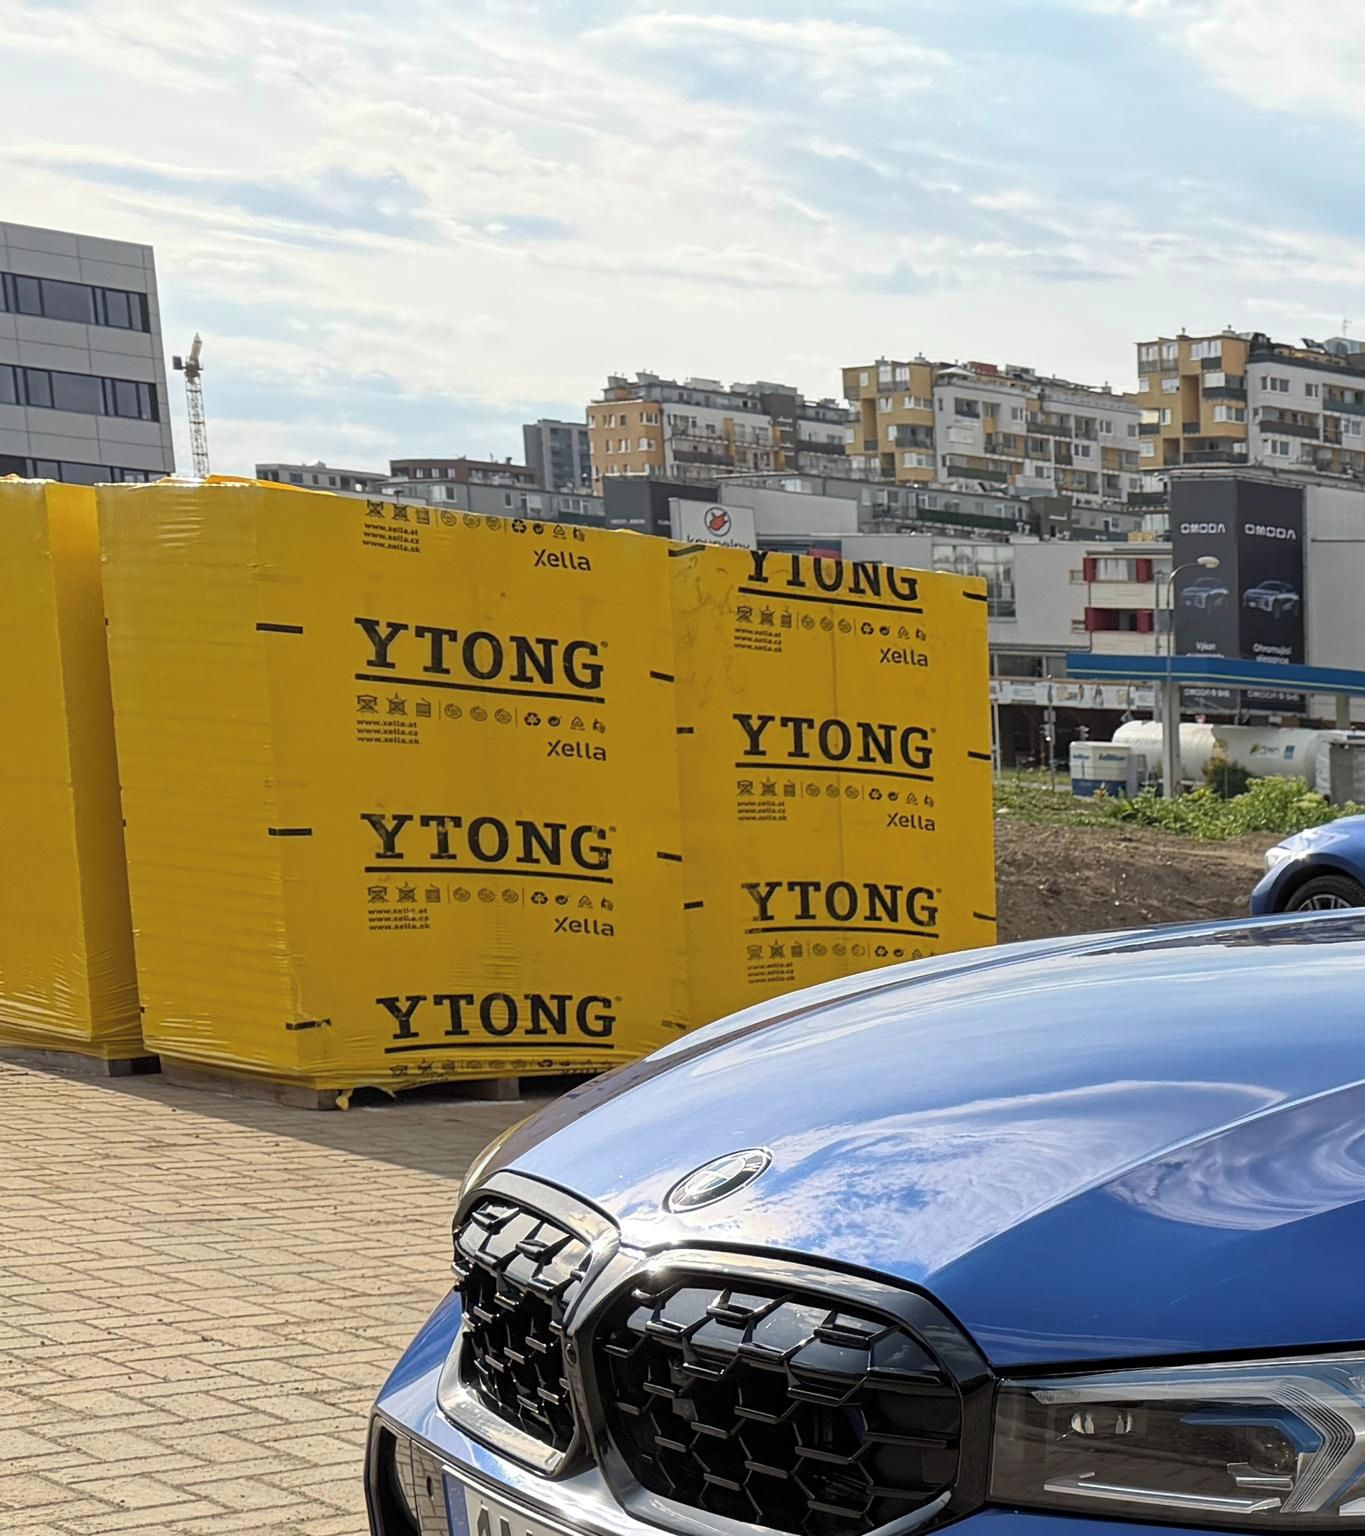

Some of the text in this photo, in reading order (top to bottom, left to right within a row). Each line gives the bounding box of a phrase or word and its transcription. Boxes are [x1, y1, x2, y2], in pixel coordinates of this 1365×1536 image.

[1180, 523, 1226, 534] OMODA
[1244, 524, 1297, 540] OMODA
[533, 549, 592, 571] Xella
[354, 617, 604, 690] YTONG
[879, 648, 929, 668] Xella
[546, 740, 607, 761] Xella
[733, 713, 933, 769] YTONG
[886, 812, 936, 832] Xella
[360, 813, 613, 870] YTONG
[741, 881, 939, 927] YTONG
[553, 916, 615, 937] Xella
[376, 992, 617, 1038] YTONG
